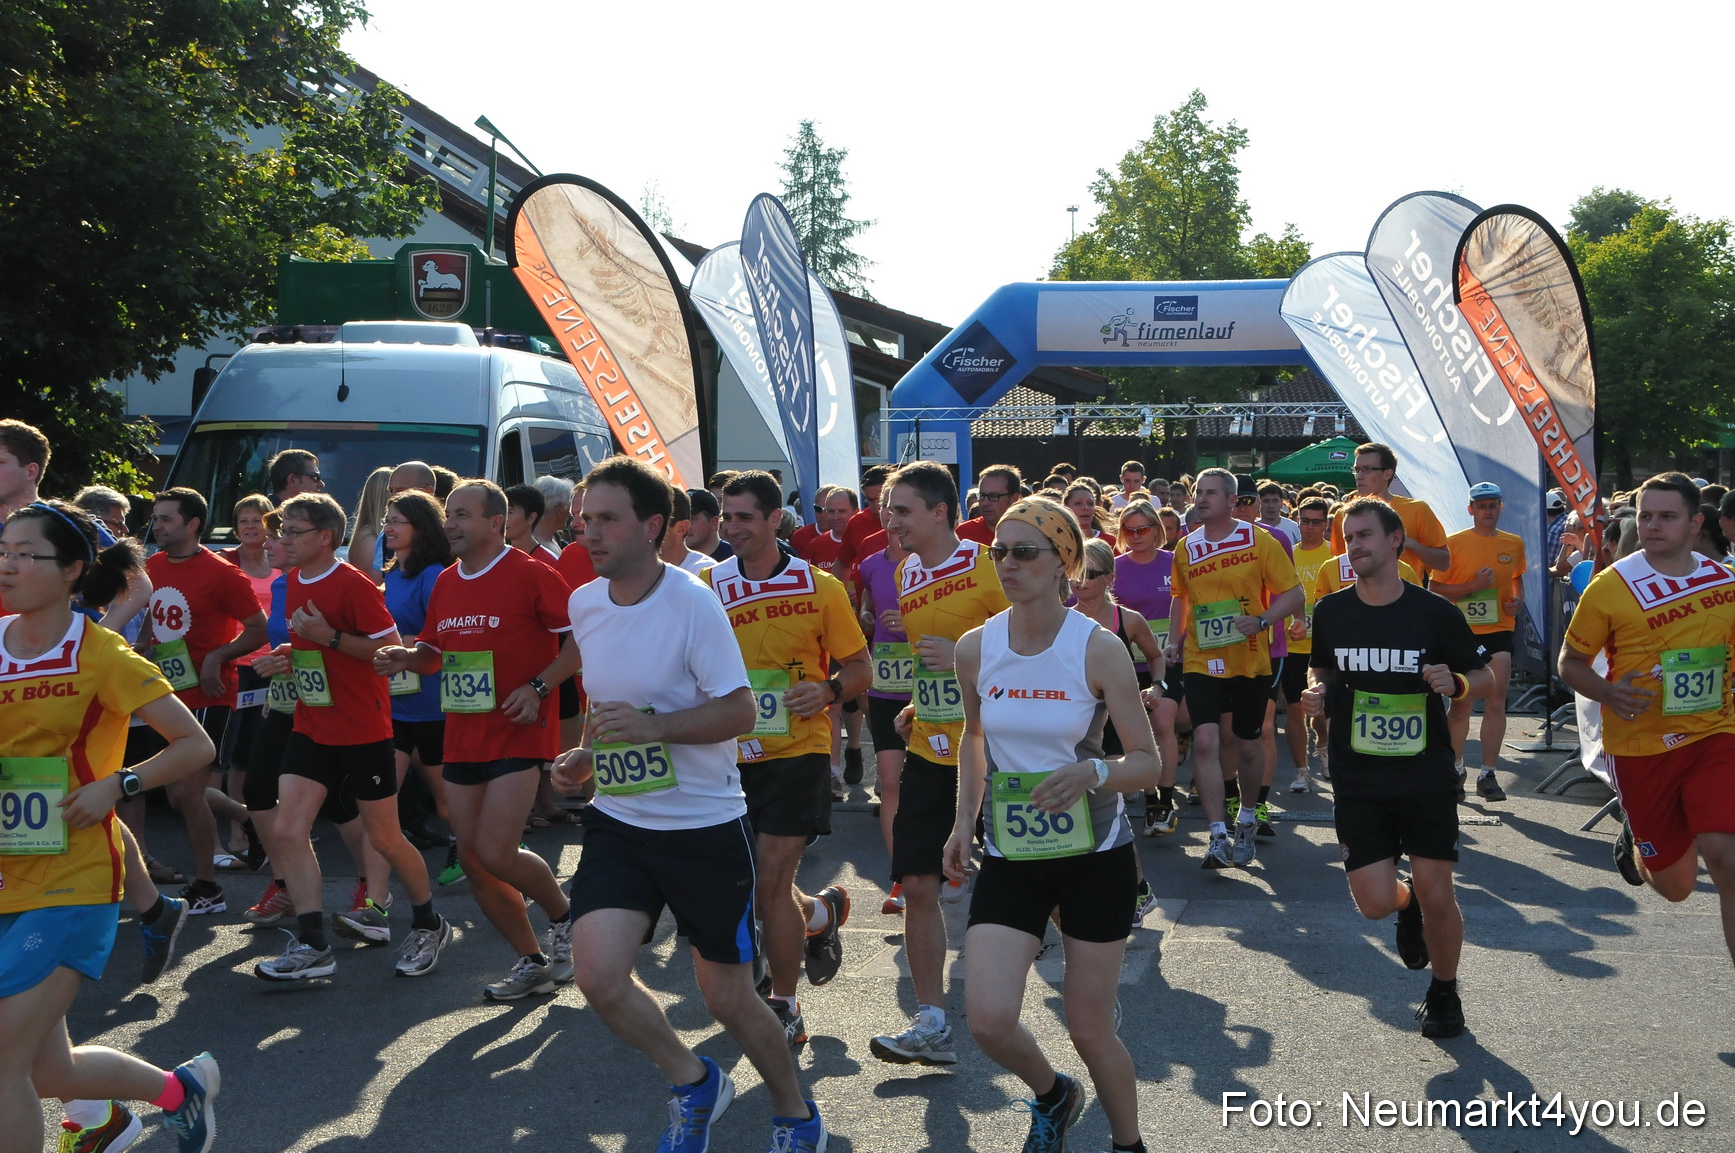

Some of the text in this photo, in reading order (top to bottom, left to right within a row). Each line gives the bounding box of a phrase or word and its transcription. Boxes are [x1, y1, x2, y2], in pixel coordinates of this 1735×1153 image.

[428, 303, 452, 313] 1628
[1138, 321, 1236, 340] firmenlauf
[953, 356, 1004, 367] Fischer
[1188, 551, 1258, 580] MAX BÖGL
[901, 576, 978, 617] MAX BÖGL
[152, 599, 183, 631] 48
[765, 601, 819, 620] BÖGL
[1467, 602, 1487, 617] 53
[1646, 602, 1698, 630] MAX
[1200, 616, 1234, 638] 797
[157, 658, 186, 681] 59
[878, 660, 913, 680] 612
[1334, 648, 1420, 673] THULE
[22, 681, 80, 701] BÖGL
[271, 681, 300, 702] 618
[441, 672, 493, 698] 1334
[918, 679, 961, 706] 815
[1008, 689, 1071, 701] KLEBL
[1674, 669, 1715, 699] 831
[1355, 714, 1423, 740] 1390
[595, 745, 669, 786] 5095
[0, 792, 48, 830] 90
[1006, 803, 1075, 838] 536
[1033, 845, 1056, 853] Dynamics
